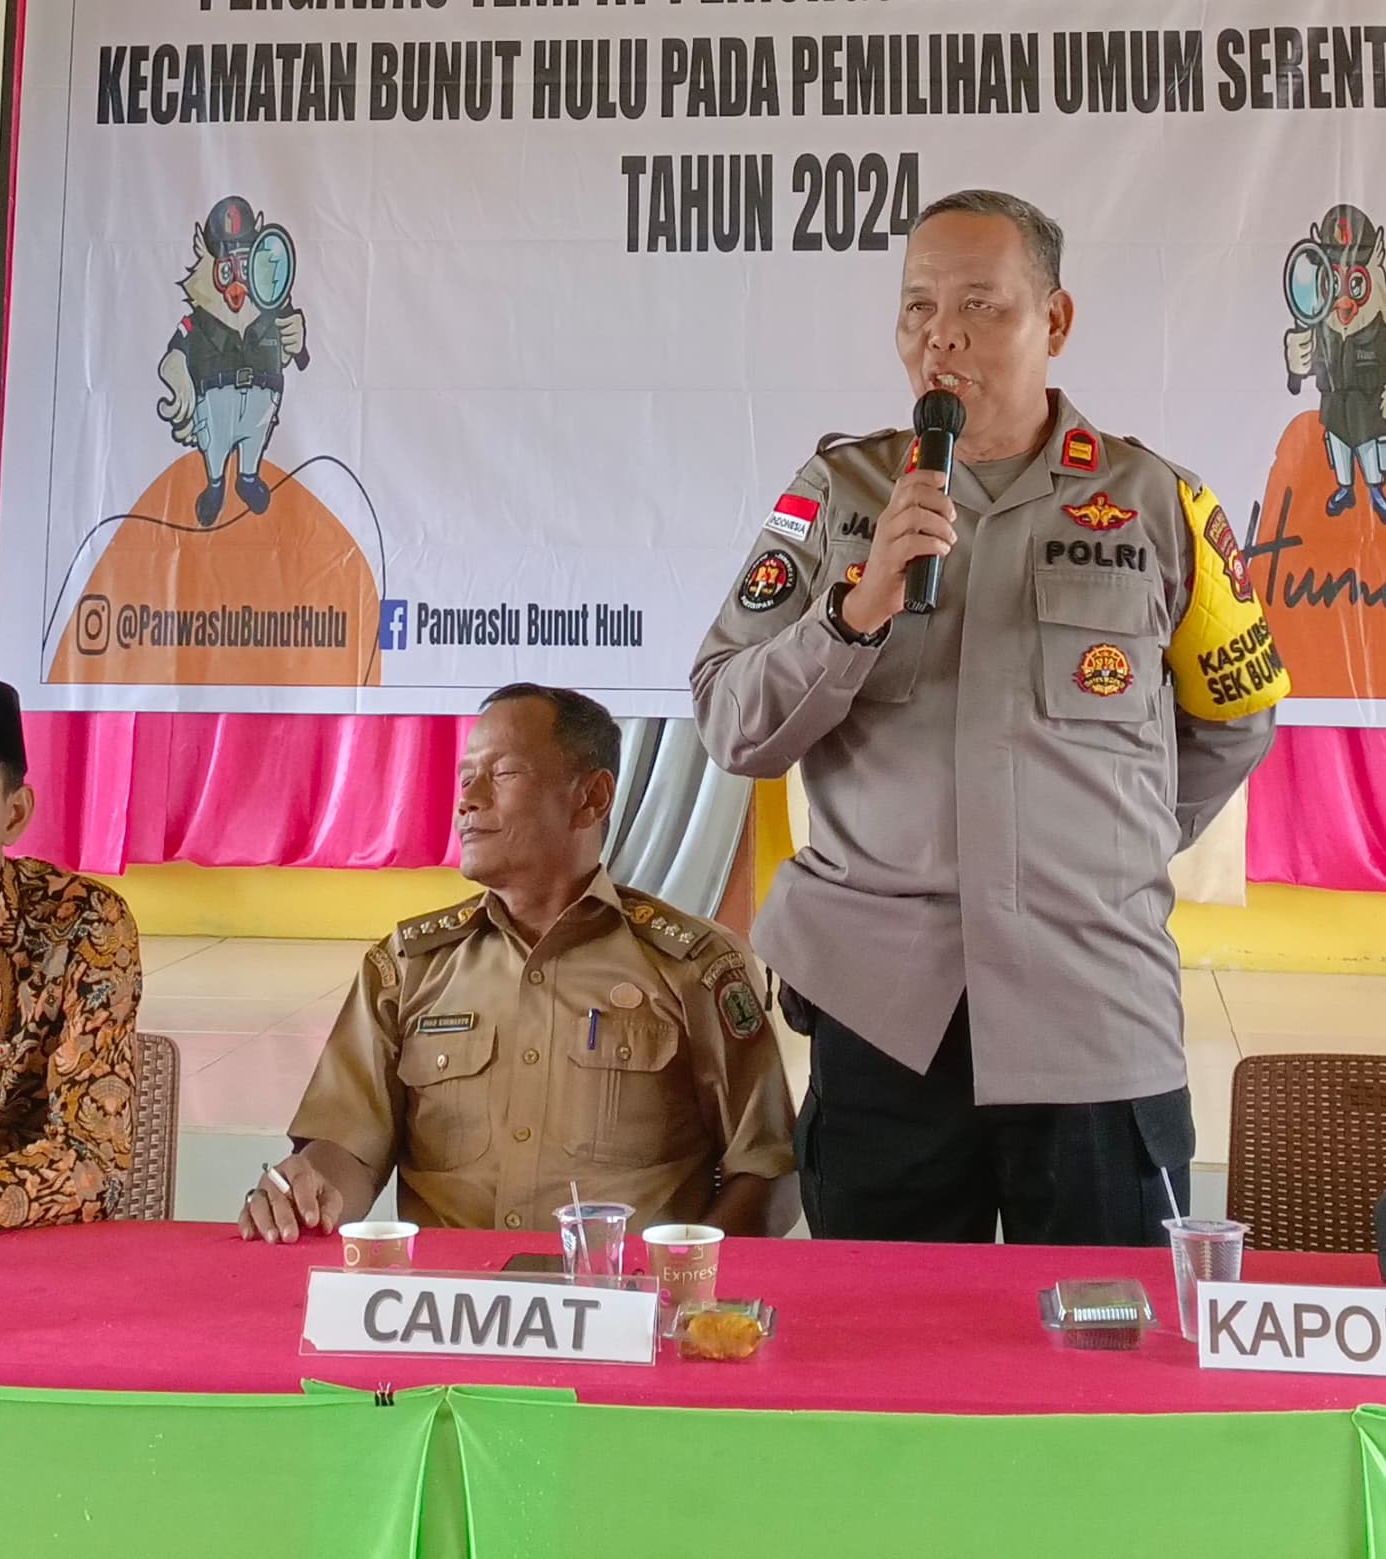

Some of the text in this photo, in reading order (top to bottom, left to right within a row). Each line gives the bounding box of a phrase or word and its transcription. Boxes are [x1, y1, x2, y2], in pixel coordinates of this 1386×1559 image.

[96, 42, 358, 125] KECAMATAN
[369, 39, 521, 122] BUNUT
[531, 37, 648, 121] HULU
[660, 35, 779, 119] PADA
[791, 31, 1041, 117] PEMILIHAN
[1053, 28, 1205, 115] UMUM
[620, 152, 920, 253] TAHUN 2024
[769, 515, 807, 535] INDONESIA
[842, 511, 877, 540] JA
[1045, 539, 1147, 573] POLRI
[115, 603, 347, 650] @PanwasluBunutHulu
[416, 601, 520, 648] Panwaslu
[526, 604, 588, 647] Bunut
[594, 604, 643, 647] Hulu
[1207, 667, 1252, 706] SEK
[362, 1287, 600, 1353] CAMAT
